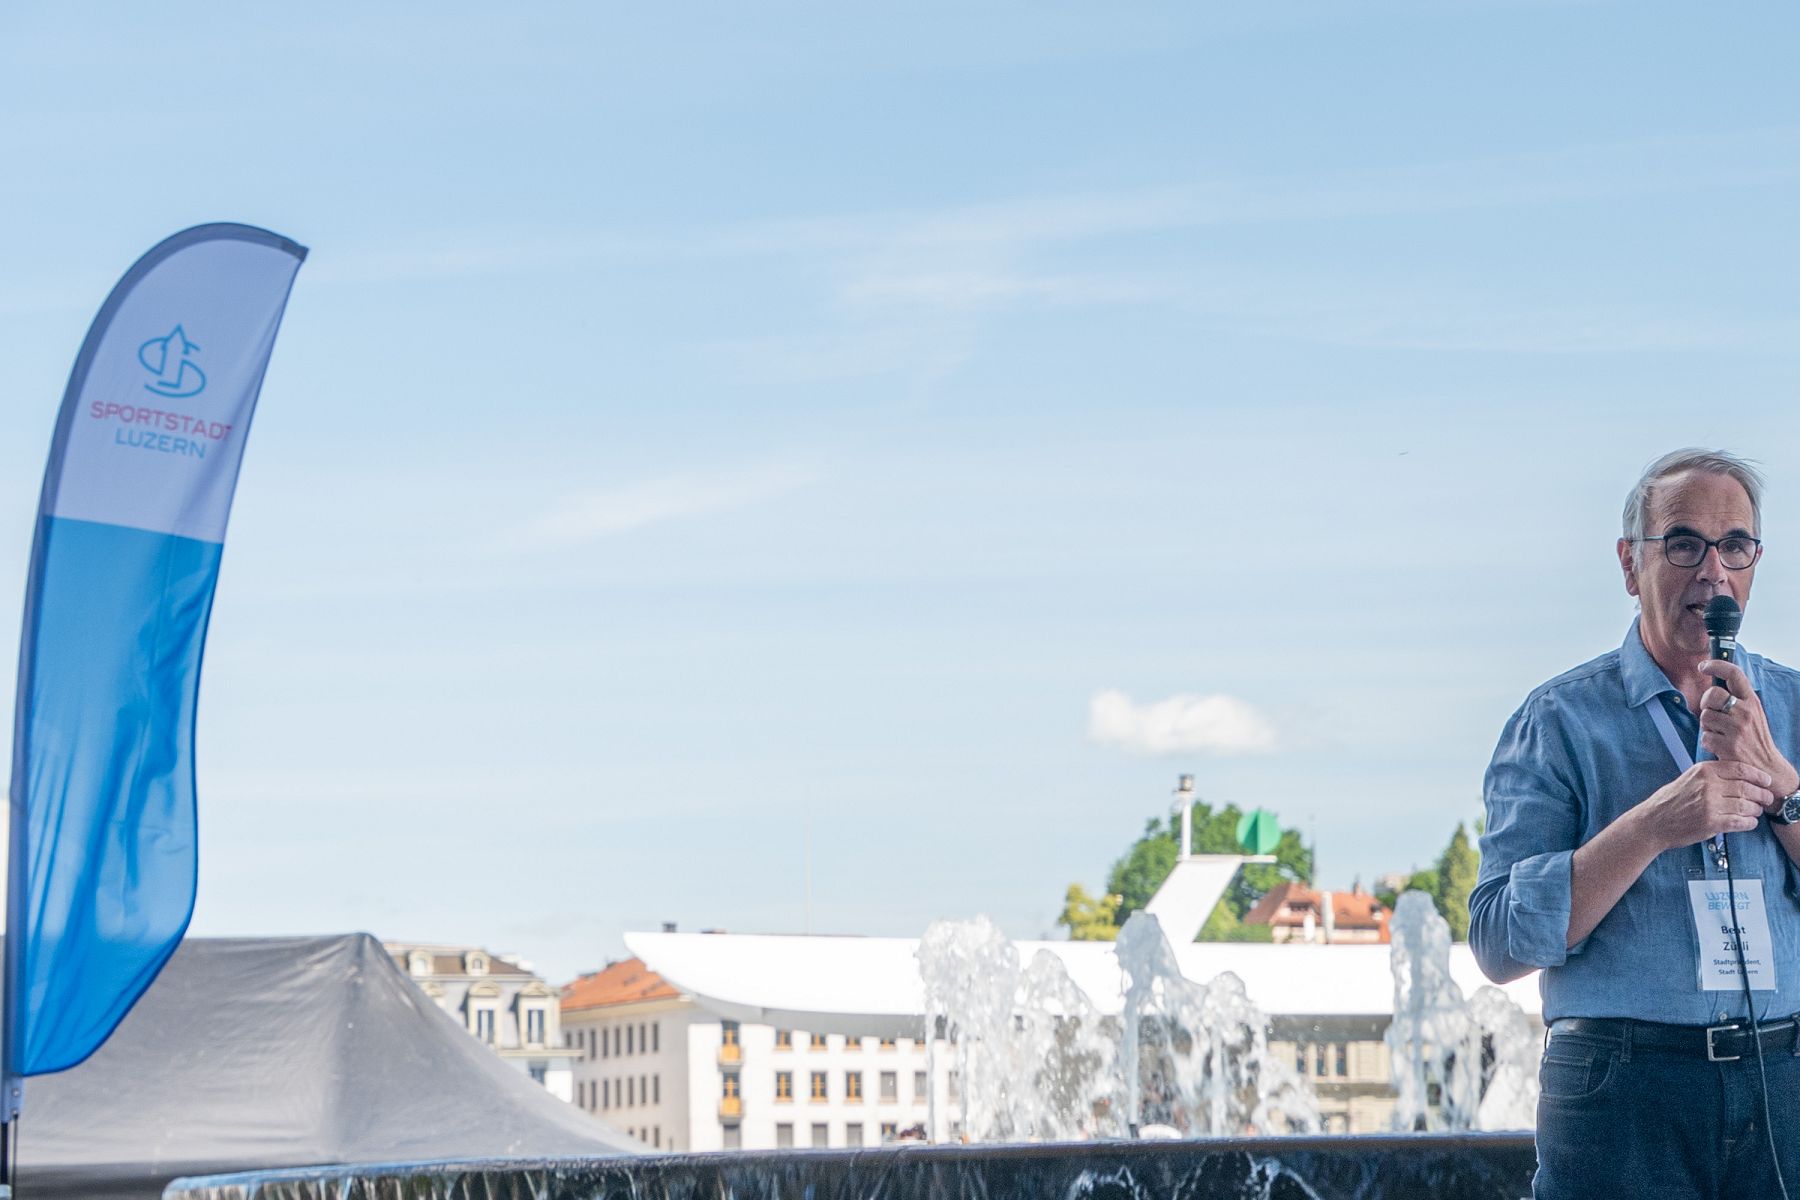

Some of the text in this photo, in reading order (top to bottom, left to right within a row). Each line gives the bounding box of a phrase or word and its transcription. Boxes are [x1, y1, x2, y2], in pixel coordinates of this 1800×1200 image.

[90, 400, 232, 440] SPORTSTADT
[115, 427, 206, 459] LUZERN
[1708, 901, 1751, 910] BEWGT
[1723, 941, 1749, 951] Züli
